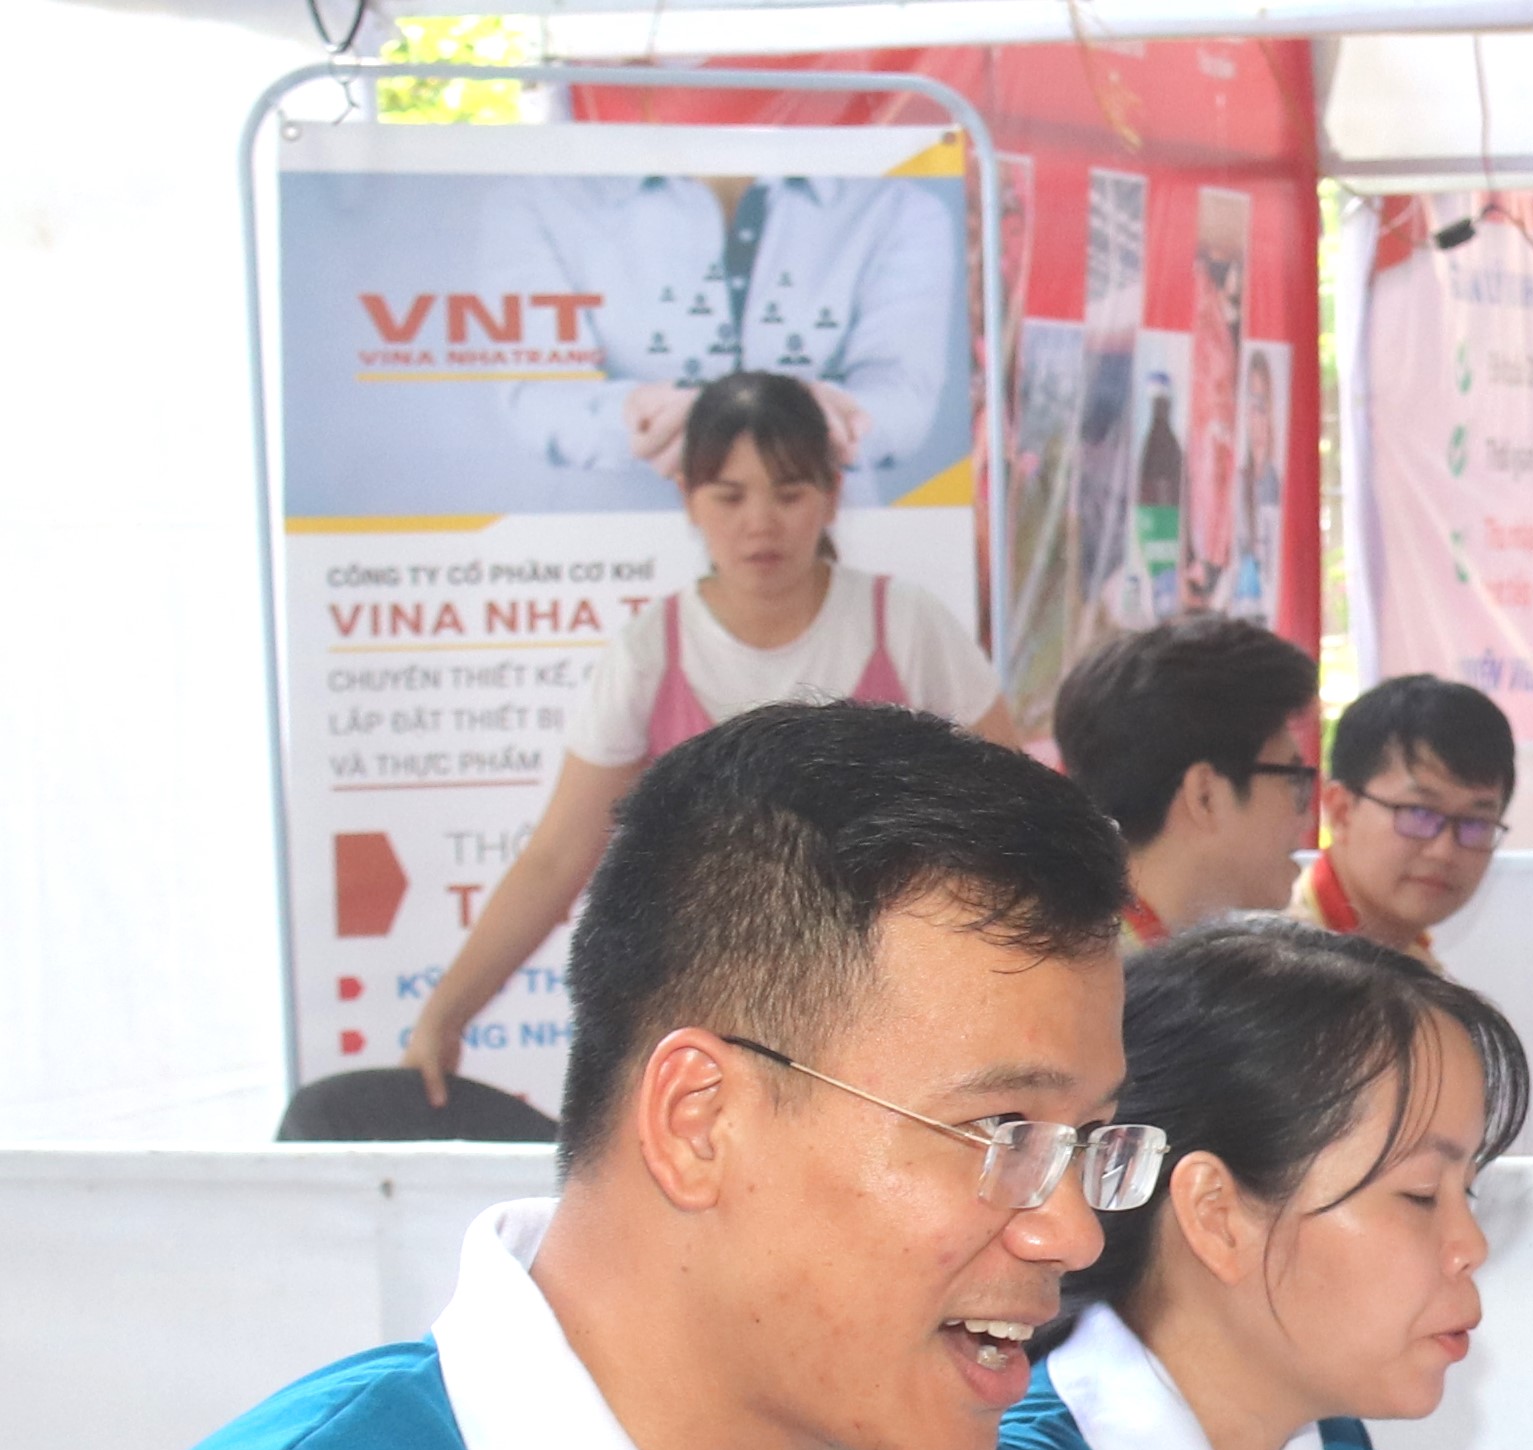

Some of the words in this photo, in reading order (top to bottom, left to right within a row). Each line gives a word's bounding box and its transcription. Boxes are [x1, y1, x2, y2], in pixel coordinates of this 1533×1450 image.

[357, 291, 606, 344] VNT
[357, 350, 436, 366] VINA
[446, 349, 607, 367] NHATRANG
[326, 561, 401, 587] CÔNG
[408, 565, 441, 586] TY
[328, 600, 466, 638] VINA
[484, 597, 605, 634] NHA
